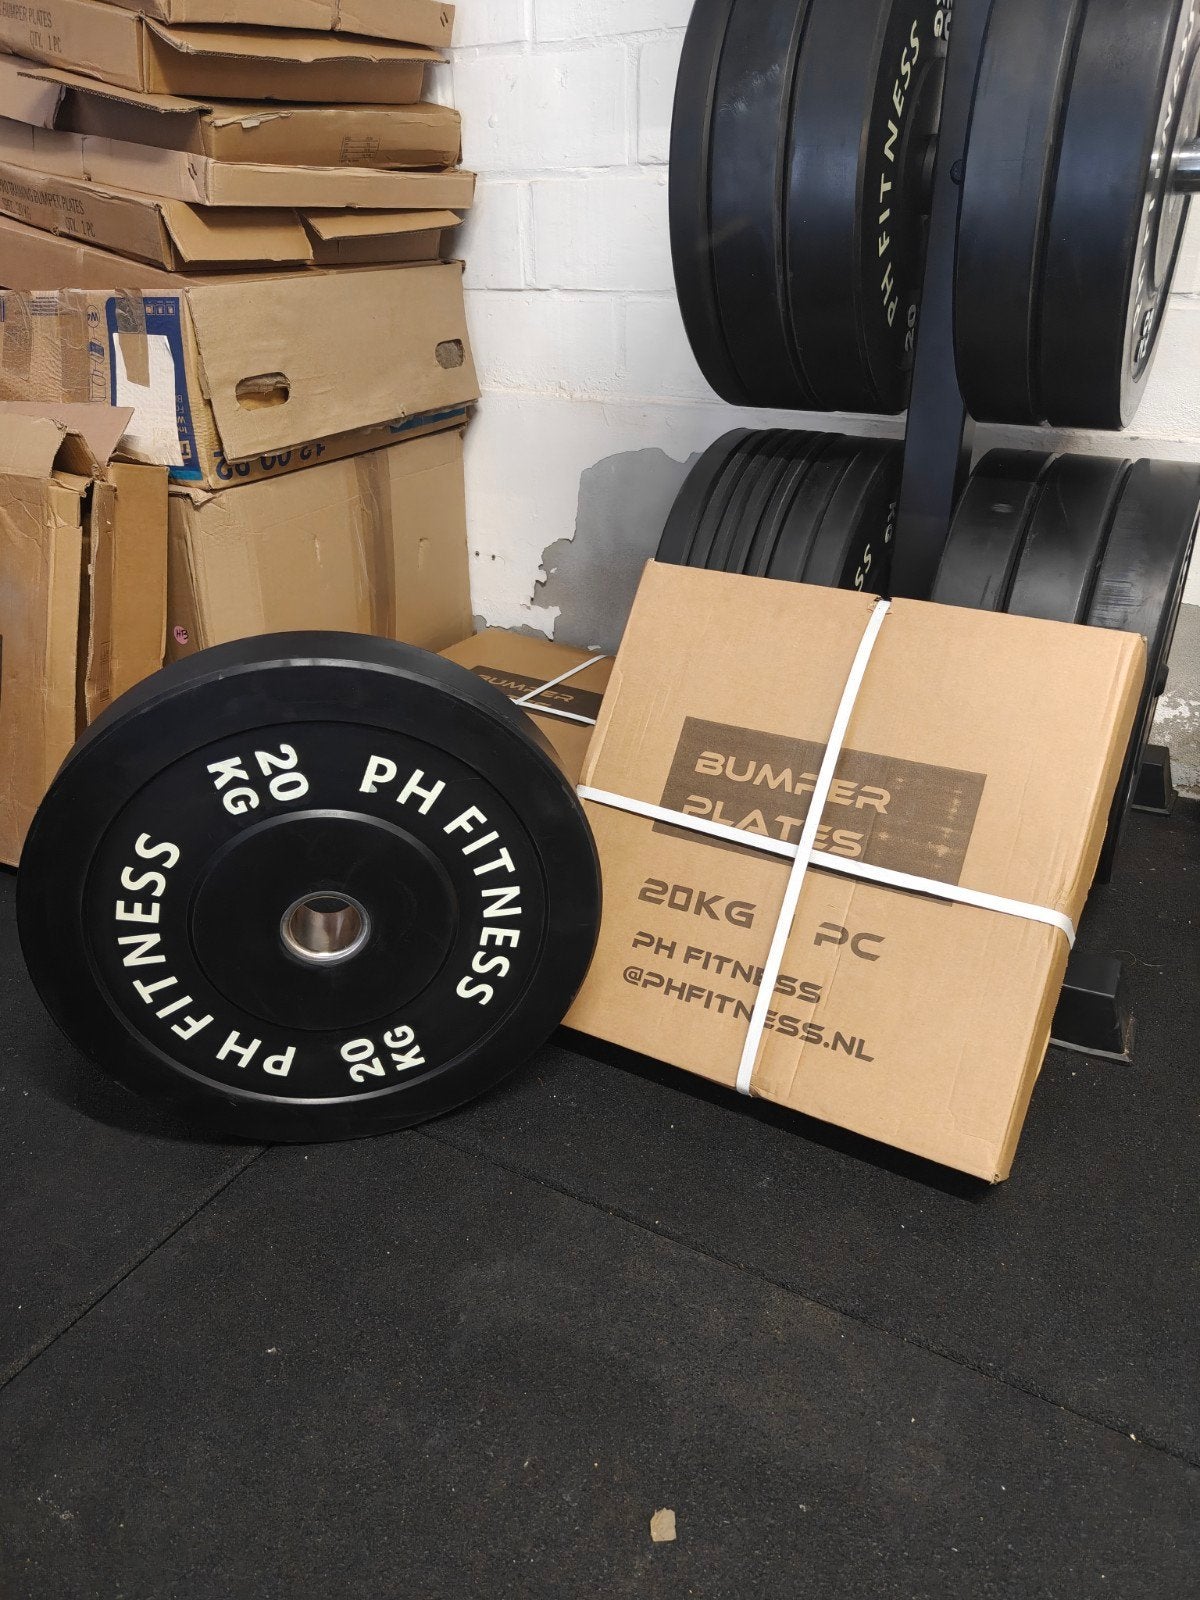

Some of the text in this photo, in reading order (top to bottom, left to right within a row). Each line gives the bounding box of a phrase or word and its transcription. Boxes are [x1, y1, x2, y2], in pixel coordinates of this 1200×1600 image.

[878, 19, 920, 258] FITNESS
[206, 756, 260, 815] KG
[254, 743, 309, 801] 20
[694, 750, 891, 815] BUMPER
[359, 754, 522, 1005] PH FITNESS
[115, 832, 297, 1077] PH FITNESS
[637, 877, 757, 929] 20KG
[813, 921, 886, 962] PC
[631, 930, 823, 1004] PH FITNESS
[383, 1025, 427, 1071] KG
[622, 965, 875, 1063] @PHFITNESS.NL
[340, 1038, 386, 1083] 20
